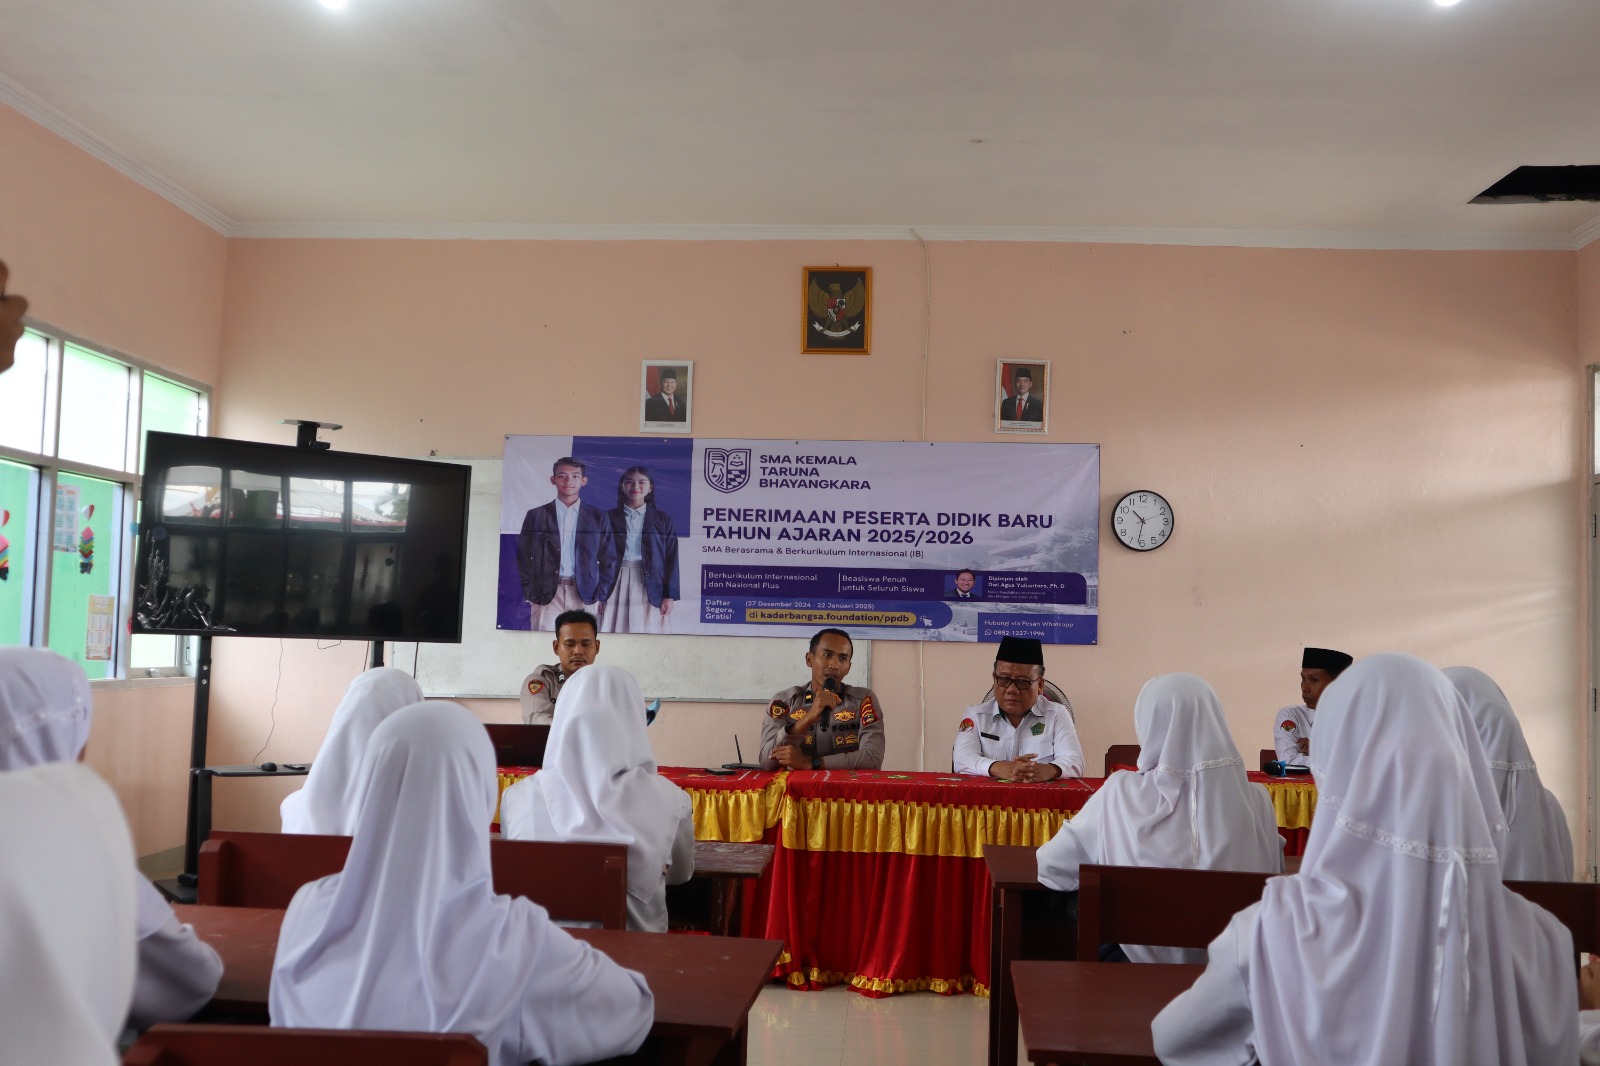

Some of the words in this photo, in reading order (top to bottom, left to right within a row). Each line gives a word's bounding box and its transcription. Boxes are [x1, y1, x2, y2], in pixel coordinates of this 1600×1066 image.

[759, 454, 792, 465] SMA
[795, 455, 858, 466] KEMALA
[759, 467, 820, 477] TARUNA
[759, 478, 872, 490] BHAYANGKARA
[1129, 498, 1135, 506] 11
[1139, 495, 1148, 503] 12
[1120, 506, 1129, 514] 10
[1160, 506, 1166, 516] 2
[703, 507, 837, 525] PENERIMAAN
[842, 510, 931, 527] PESERTA
[936, 512, 993, 528] DIDIK
[998, 513, 1053, 529] BARU
[1116, 516, 1124, 524] 9
[1162, 518, 1170, 526] 3
[702, 525, 772, 541] TAHUN
[777, 526, 862, 543] AJARAN
[867, 528, 974, 547] 2025/2026
[1120, 528, 1126, 536] 8
[1158, 530, 1166, 538] 4
[1150, 536, 1156, 544] 5
[702, 545, 722, 553] SMA
[725, 546, 774, 554] Berasrama
[776, 547, 783, 555] &
[785, 547, 846, 556] Berkurikulum
[848, 548, 908, 557] Internasional
[909, 550, 924, 559] (IB)
[708, 571, 763, 580] Berkurikulum
[764, 573, 818, 581] Internasional
[842, 575, 880, 583] Beasiswa
[882, 575, 907, 583] Penuh
[725, 581, 761, 589] Nasional
[842, 583, 865, 591] untuk
[867, 584, 899, 592] Seluruh
[901, 585, 925, 593] Siswa
[705, 606, 735, 614] Segera,
[749, 611, 758, 619] di
[760, 611, 909, 623] kaderbangsa.foundation/ppdb
